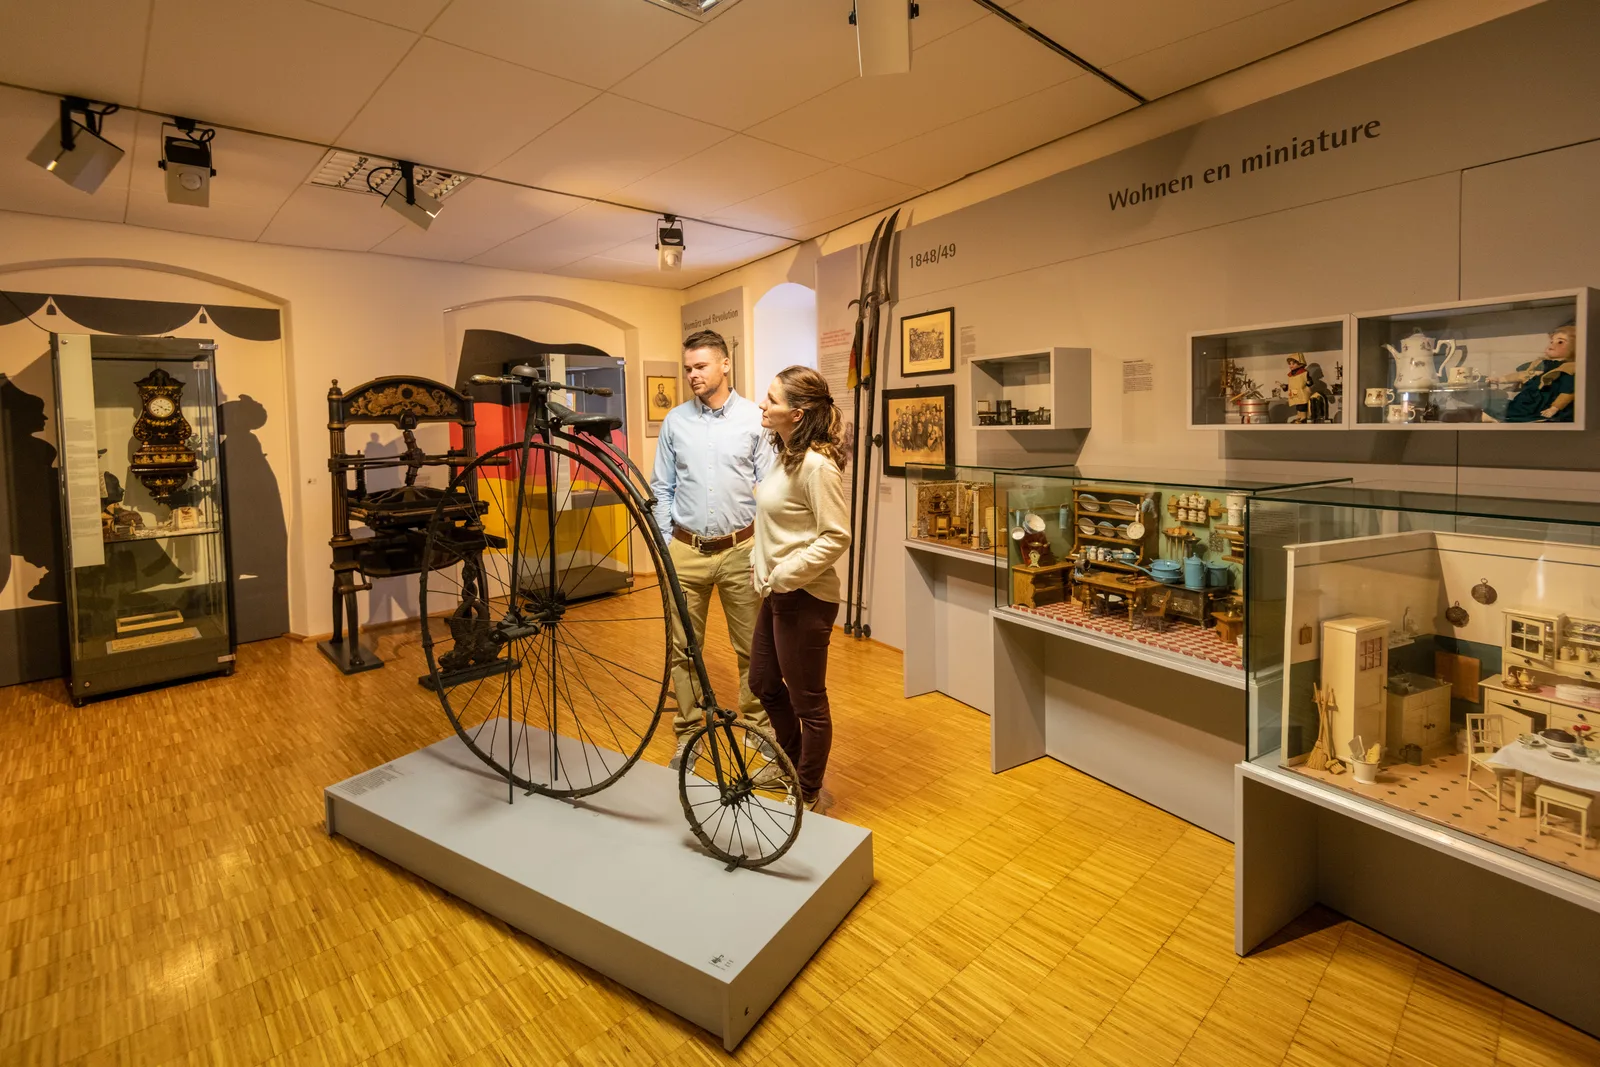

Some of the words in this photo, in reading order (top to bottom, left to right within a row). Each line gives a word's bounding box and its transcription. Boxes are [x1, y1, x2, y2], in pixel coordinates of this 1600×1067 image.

[1108, 173, 1194, 211] Wohnen
[1203, 163, 1231, 184] en
[1241, 119, 1381, 174] miniature
[909, 243, 956, 269] 1848/49
[702, 315, 711, 326] und
[712, 308, 739, 323] Revolution
